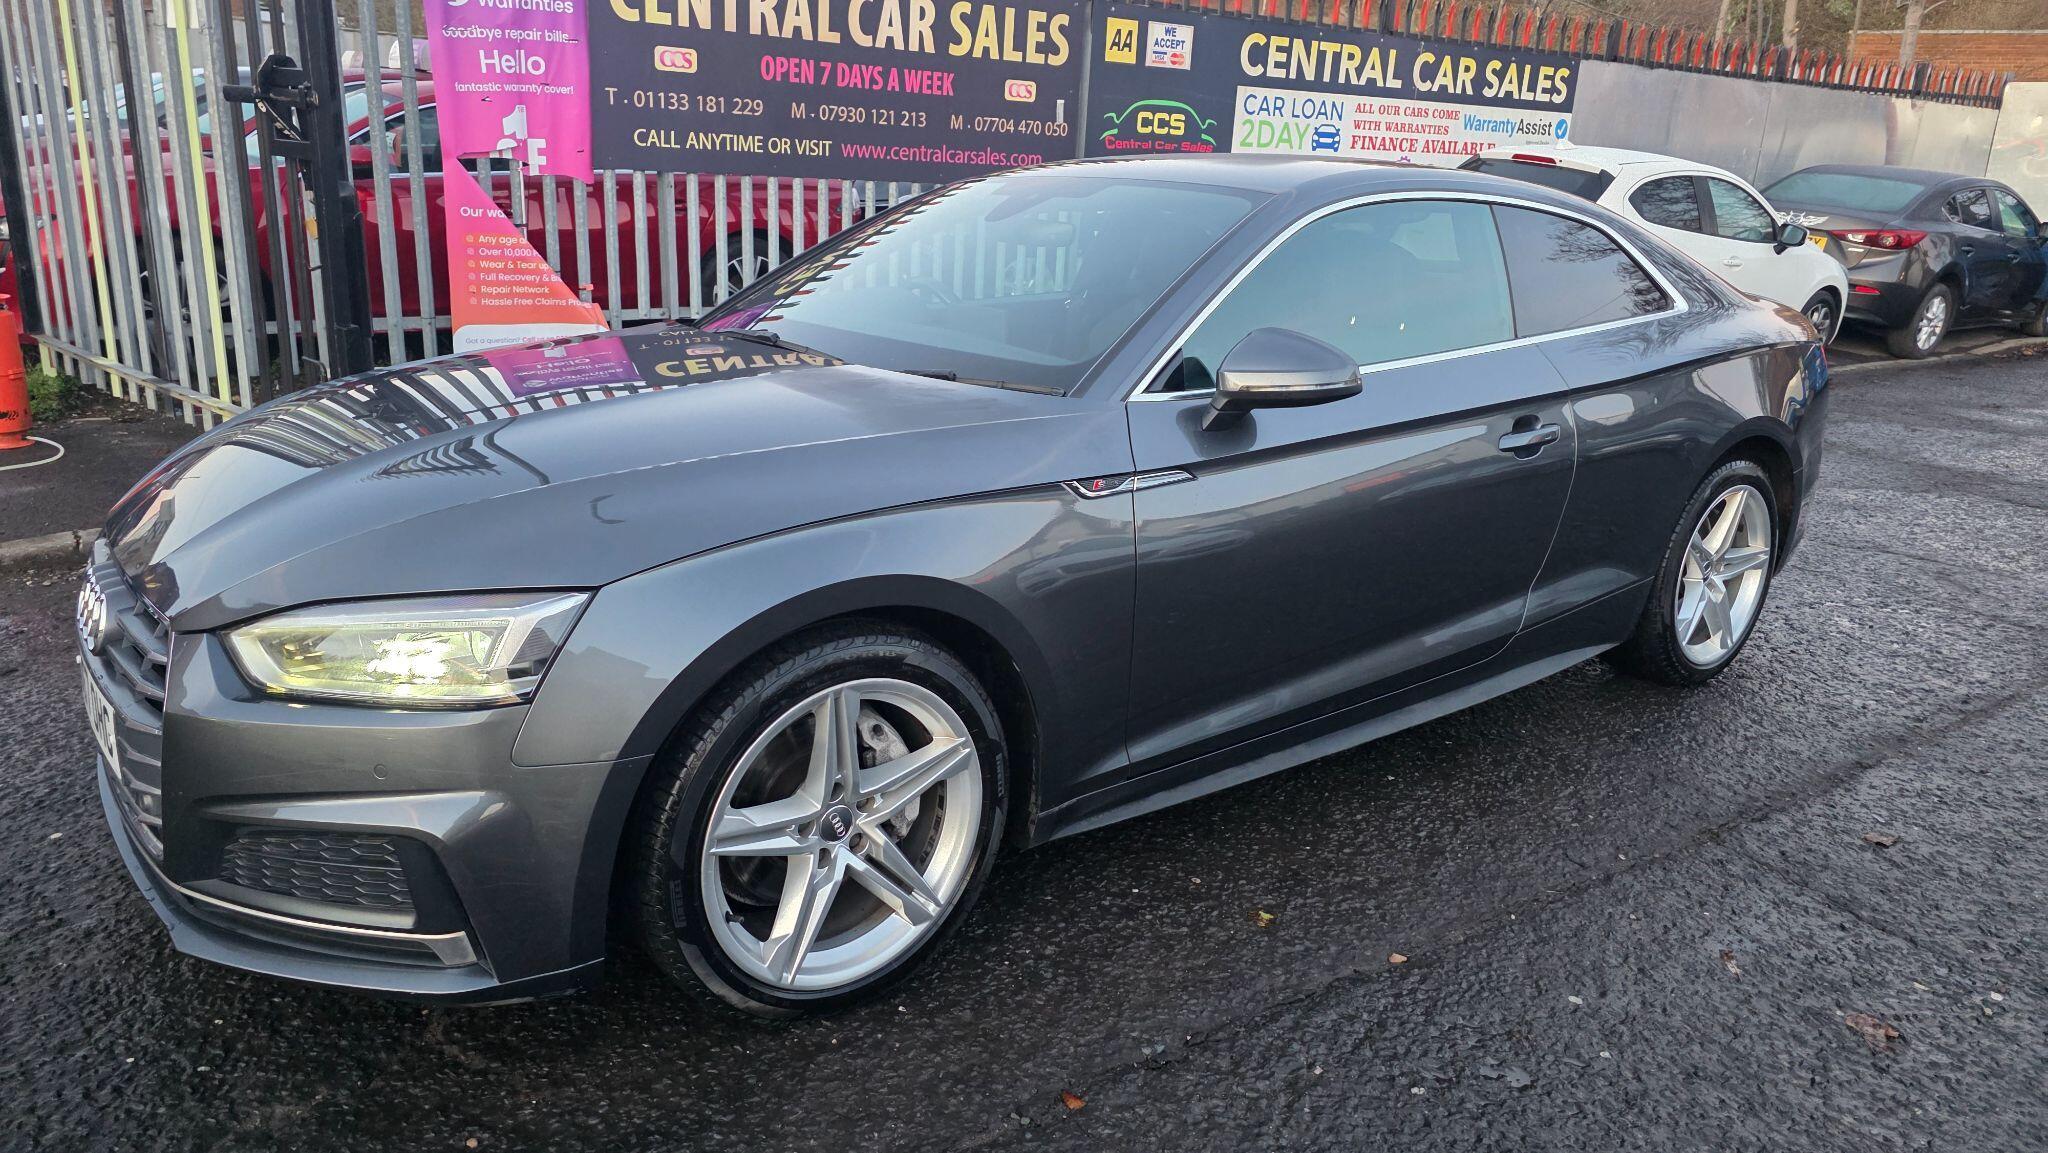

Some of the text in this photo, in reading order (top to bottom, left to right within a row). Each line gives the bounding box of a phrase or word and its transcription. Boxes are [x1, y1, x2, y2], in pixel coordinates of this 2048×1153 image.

[505, 28, 541, 42] repair
[848, 0, 936, 53] CAR
[949, 1, 1070, 66] SALES
[1164, 26, 1177, 37] WE
[1109, 28, 1133, 53] AA
[1153, 37, 1185, 50] ACCEPT
[479, 49, 546, 75] Hello
[1240, 32, 1570, 104] CENTRAL CAR SALES
[760, 55, 954, 96] OPEN 7 DAYS A WEEK
[455, 82, 501, 92] fantastic
[544, 84, 574, 94] cover!
[633, 90, 690, 111] 01133
[696, 96, 725, 114] 181
[732, 98, 764, 116] 229
[819, 105, 866, 123] 07930
[871, 109, 895, 126] 121
[901, 111, 927, 127] 213
[974, 117, 1014, 133] 07704
[1018, 120, 1042, 135] 470
[1045, 122, 1068, 136] 050
[1243, 93, 1344, 121] CAR LOAN
[1355, 102, 1461, 120] ALL OUR CARS COME
[1137, 111, 1185, 135] CCS
[1353, 120, 1449, 136] WITH WARRANTIES
[1463, 113, 1553, 138] WarrantyAssist
[1240, 118, 1311, 149] 2DAY
[633, 128, 1042, 166] CALL ANYTIME OR VISIT www.centralcarsales.com
[1105, 135, 1213, 153] Central Car Sales
[1350, 135, 1418, 152] FINANCE
[460, 206, 483, 217] Our
[479, 234, 497, 244] Any
[499, 236, 517, 245] age
[479, 248, 501, 256] Over
[504, 248, 531, 257] 10,000
[480, 260, 505, 269] Wear
[507, 261, 514, 269] &
[517, 261, 535, 269] Tear
[480, 272, 496, 280] Full
[498, 272, 540, 283] Recovery
[542, 273, 549, 281] &
[481, 285, 550, 295] Repair Network
[481, 297, 512, 306] Hassle
[514, 297, 532, 306] Free
[535, 297, 566, 306] Claims
